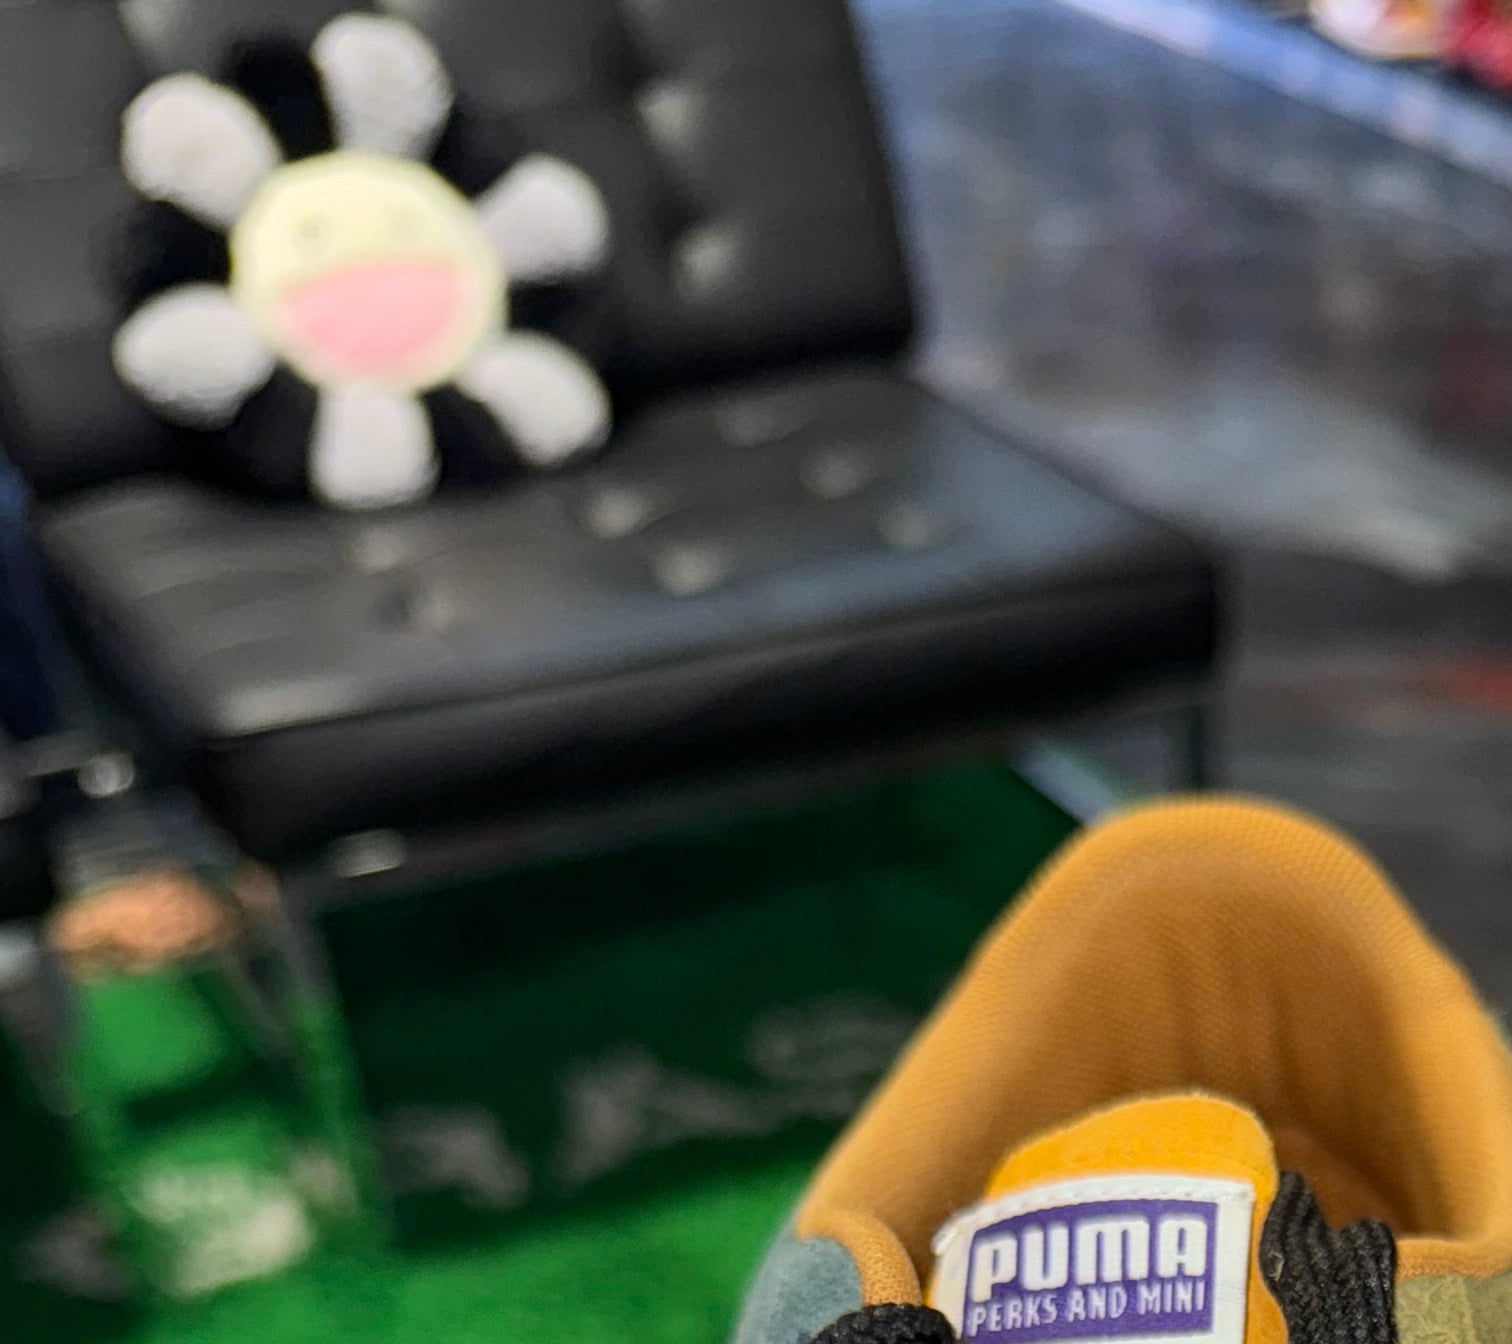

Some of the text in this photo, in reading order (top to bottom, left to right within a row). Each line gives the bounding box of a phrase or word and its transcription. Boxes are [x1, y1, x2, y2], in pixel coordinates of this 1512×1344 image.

[972, 1217, 1207, 1303] PUMA
[967, 1281, 1205, 1337] PERKS AND MINI
